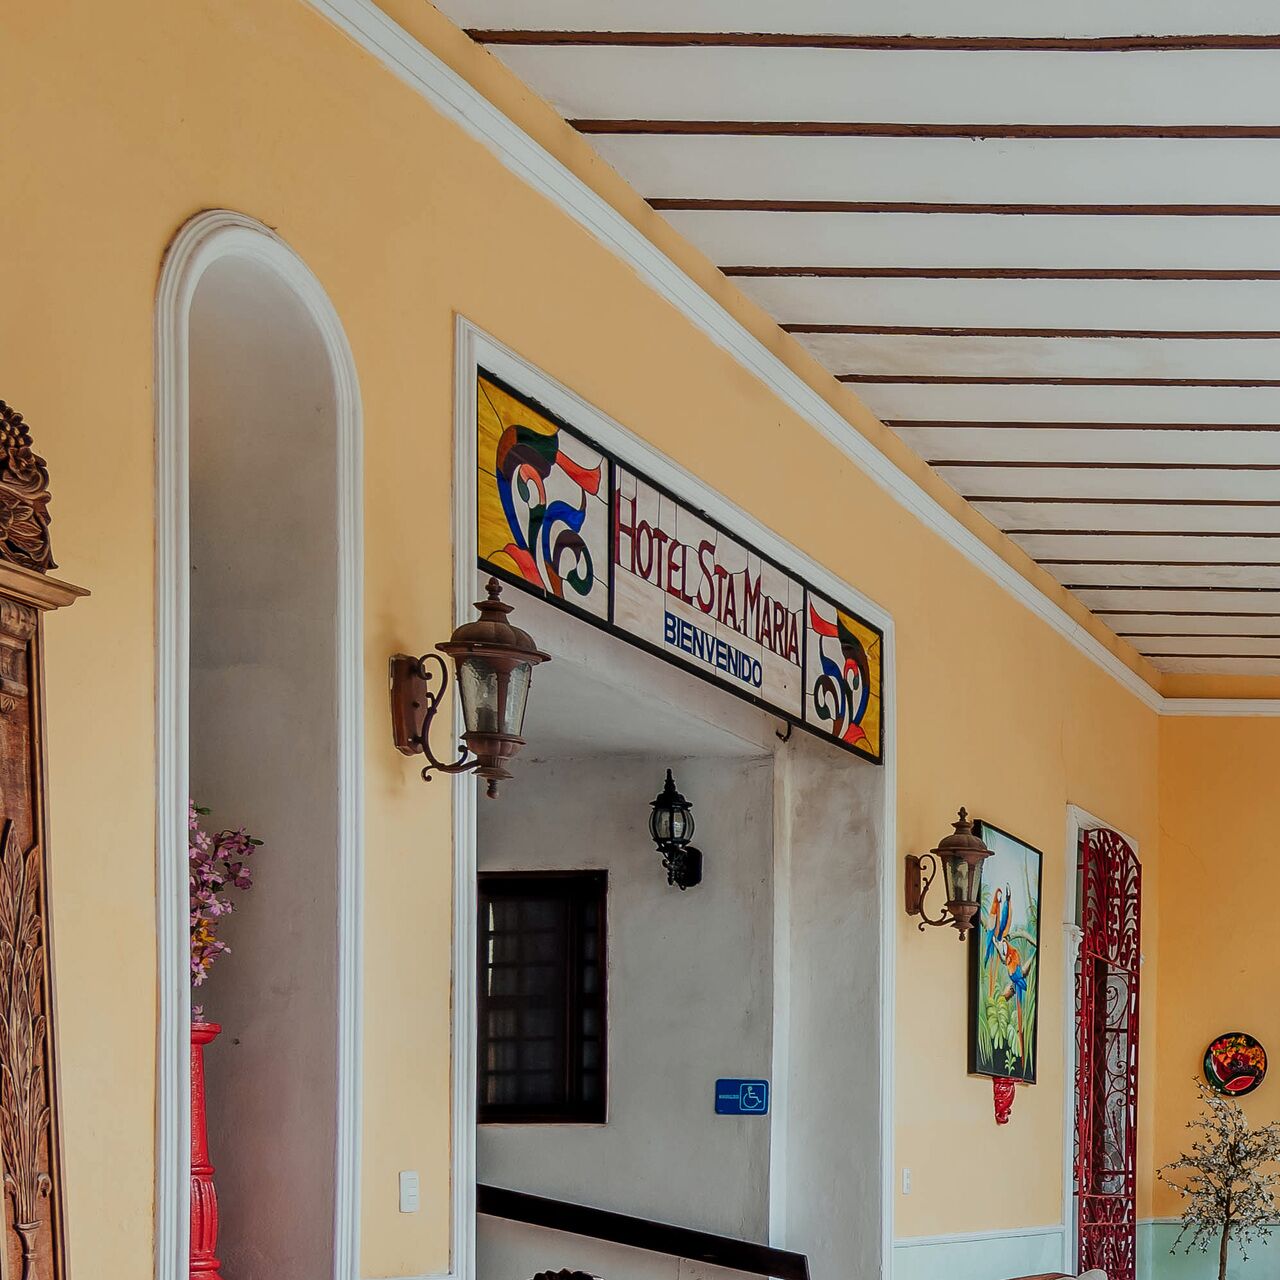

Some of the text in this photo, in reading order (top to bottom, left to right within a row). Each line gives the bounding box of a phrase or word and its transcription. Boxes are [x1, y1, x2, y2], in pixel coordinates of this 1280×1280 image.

[615, 488, 693, 606] HOTEL
[744, 568, 800, 667] MARIA
[664, 610, 763, 688] BIENVENIDO
